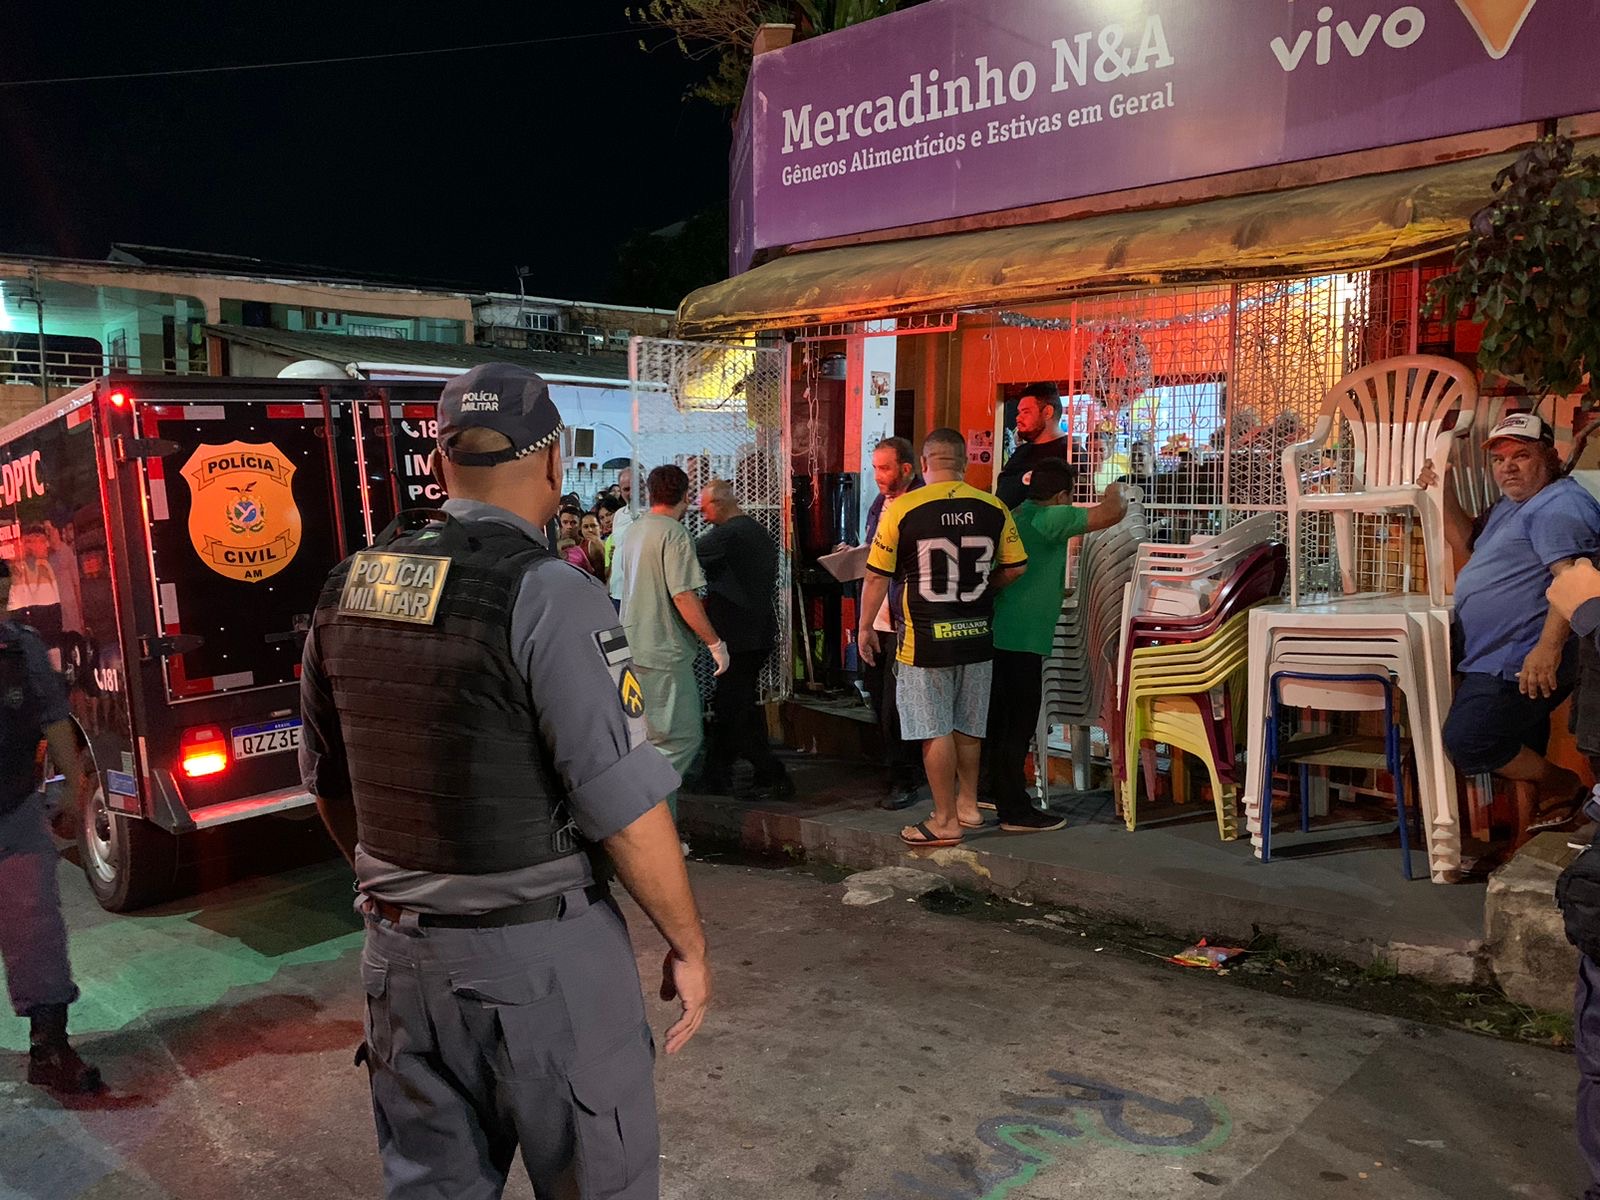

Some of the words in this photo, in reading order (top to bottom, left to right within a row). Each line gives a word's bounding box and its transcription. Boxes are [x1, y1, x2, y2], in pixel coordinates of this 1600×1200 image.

[1270, 6, 1426, 72] vivo
[781, 56, 1037, 154] Mercadinho
[1051, 14, 1175, 93] N&A
[782, 159, 847, 186] Gêneros
[850, 132, 966, 173] Alimentícios
[971, 129, 982, 147] e
[987, 112, 1062, 145] Estivas
[1067, 103, 1103, 128] em
[1109, 82, 1175, 119] Geral
[461, 402, 500, 412] MILITAR
[462, 390, 500, 402] POLÍCIA
[208, 454, 274, 474] POLÍCIA
[224, 548, 277, 563] CIVIL
[916, 536, 994, 602] 03
[244, 569, 263, 579] AM
[353, 559, 435, 589] POLÍCIA
[345, 587, 430, 617] MILITAR
[102, 668, 119, 692] 181
